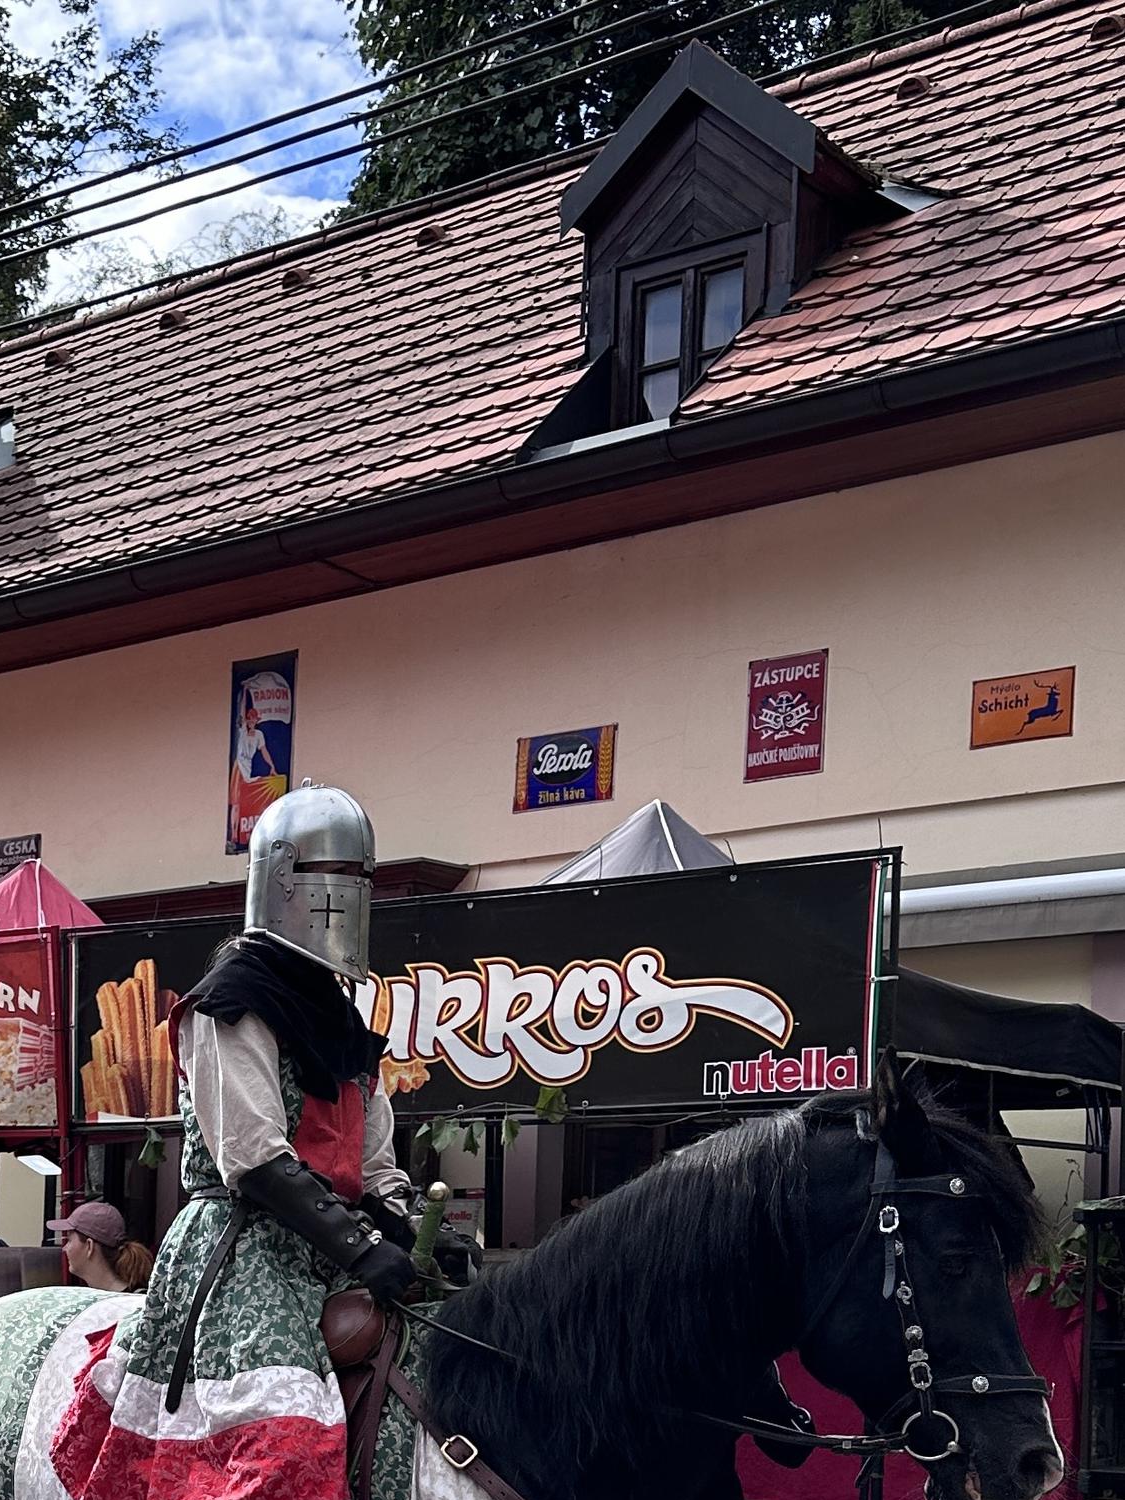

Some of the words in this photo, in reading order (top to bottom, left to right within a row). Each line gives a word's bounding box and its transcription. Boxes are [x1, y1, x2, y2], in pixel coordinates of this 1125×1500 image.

[754, 662, 820, 688] ZÁSTUPCE
[254, 688, 289, 702] RADION
[978, 693, 1030, 713] Schicht
[533, 743, 593, 775] Perola
[342, 947, 792, 1089] URROS
[704, 1047, 858, 1095] nutella
